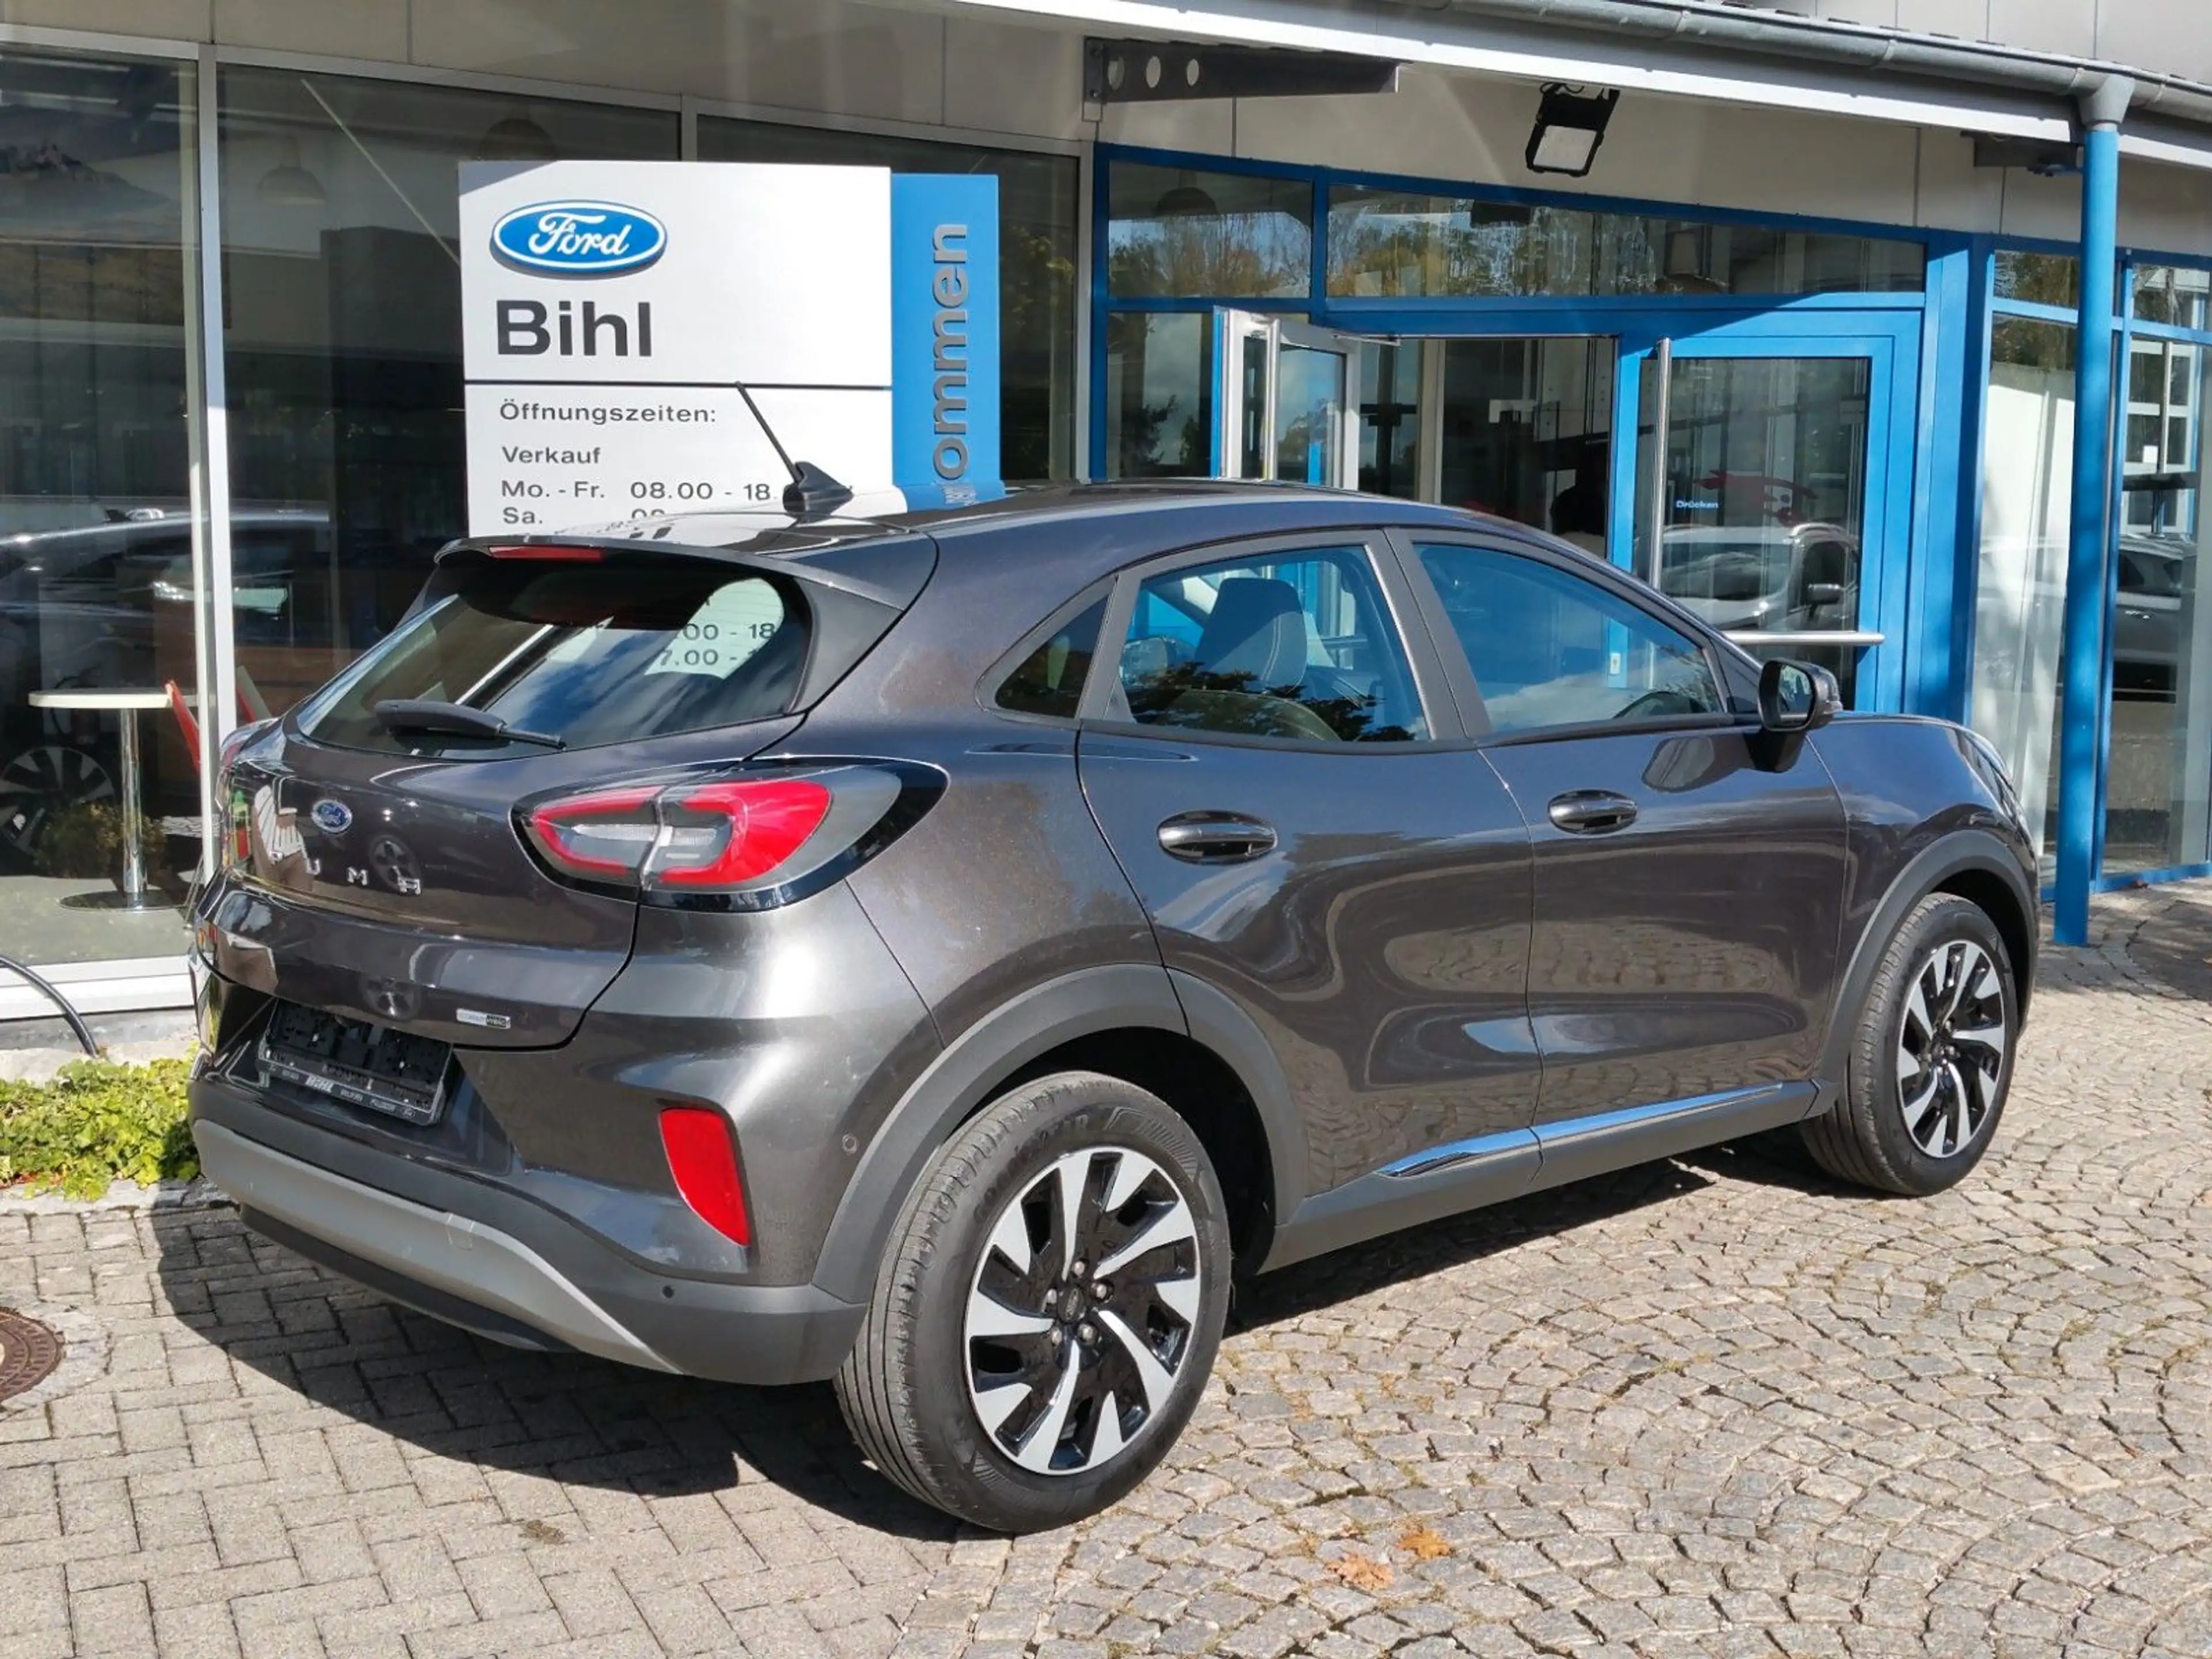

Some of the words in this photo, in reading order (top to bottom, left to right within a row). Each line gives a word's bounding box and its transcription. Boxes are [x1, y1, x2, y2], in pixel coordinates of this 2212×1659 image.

[528, 212, 632, 255] Ford
[496, 300, 652, 357] Bihl
[500, 398, 716, 425] Öffnungszeiten:
[501, 446, 601, 464] Verkauf
[501, 480, 550, 498] Mo.
[574, 481, 605, 498] Fr.
[630, 482, 713, 499] 08.00
[502, 507, 543, 524] Sa.
